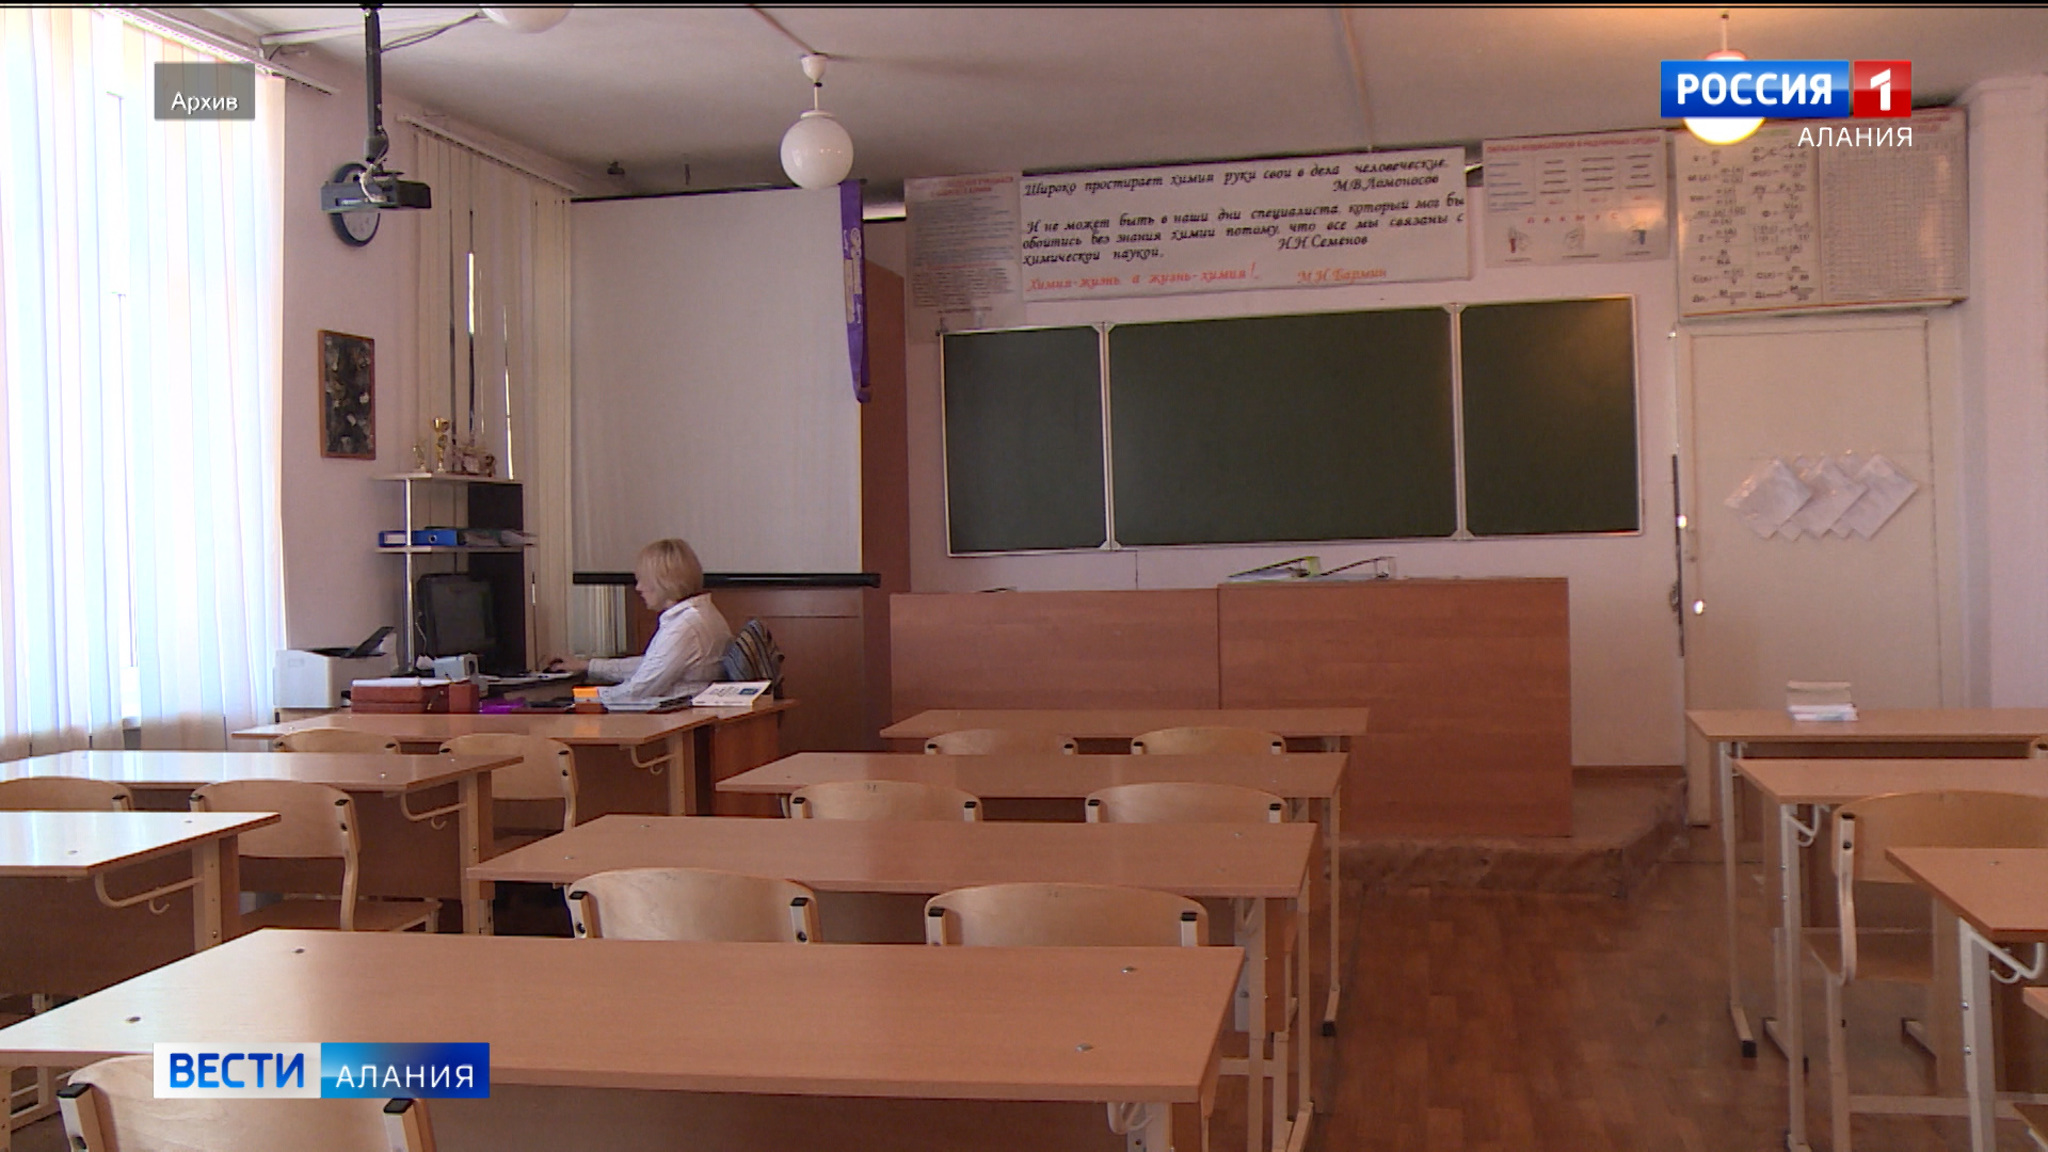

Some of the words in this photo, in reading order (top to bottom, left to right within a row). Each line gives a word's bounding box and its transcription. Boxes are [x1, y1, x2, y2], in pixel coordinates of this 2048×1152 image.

[1024, 182, 1077, 198] Широко
[1085, 176, 1163, 194] простирает
[1170, 173, 1214, 187] химия
[1223, 170, 1256, 186] руки
[1263, 168, 1292, 179] свои
[1297, 168, 1305, 177] в
[1310, 163, 1340, 177] дела
[1027, 219, 1041, 234] И
[1044, 222, 1060, 232] не
[1064, 219, 1110, 232] может
[1119, 212, 1155, 227] быть
[1161, 215, 1168, 224] в
[1173, 213, 1209, 223] наши
[1218, 207, 1242, 221] дни
[1415, 199, 1440, 209] мог
[1446, 191, 1465, 207] бы
[1091, 233, 1110, 246] без
[1116, 230, 1162, 244] знания
[1171, 228, 1216, 242] химии
[1289, 223, 1317, 233] что
[1326, 221, 1347, 231] все
[1355, 219, 1379, 230] мы
[1389, 215, 1449, 227] связаны
[1456, 213, 1465, 223] с
[1132, 273, 1142, 284] а
